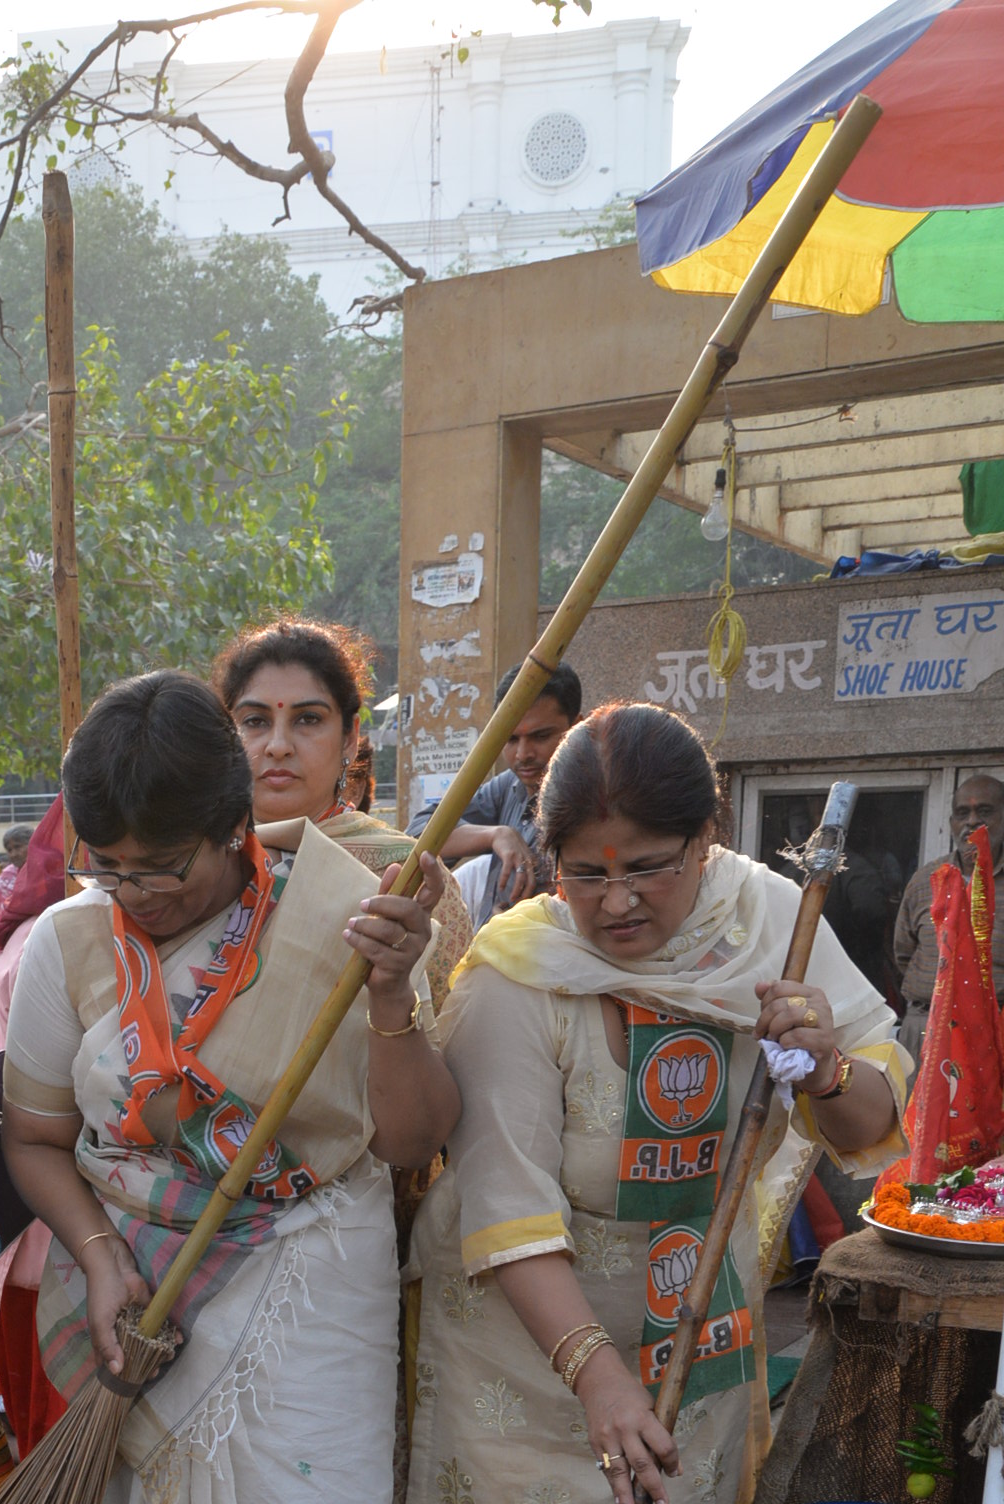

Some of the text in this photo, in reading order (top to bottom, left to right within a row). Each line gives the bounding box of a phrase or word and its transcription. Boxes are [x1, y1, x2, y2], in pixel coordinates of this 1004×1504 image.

[843, 600, 1004, 653] जूता घर
[744, 640, 827, 693] घर
[837, 658, 968, 697] SHOE HOUSE
[445, 751, 462, 759] How
